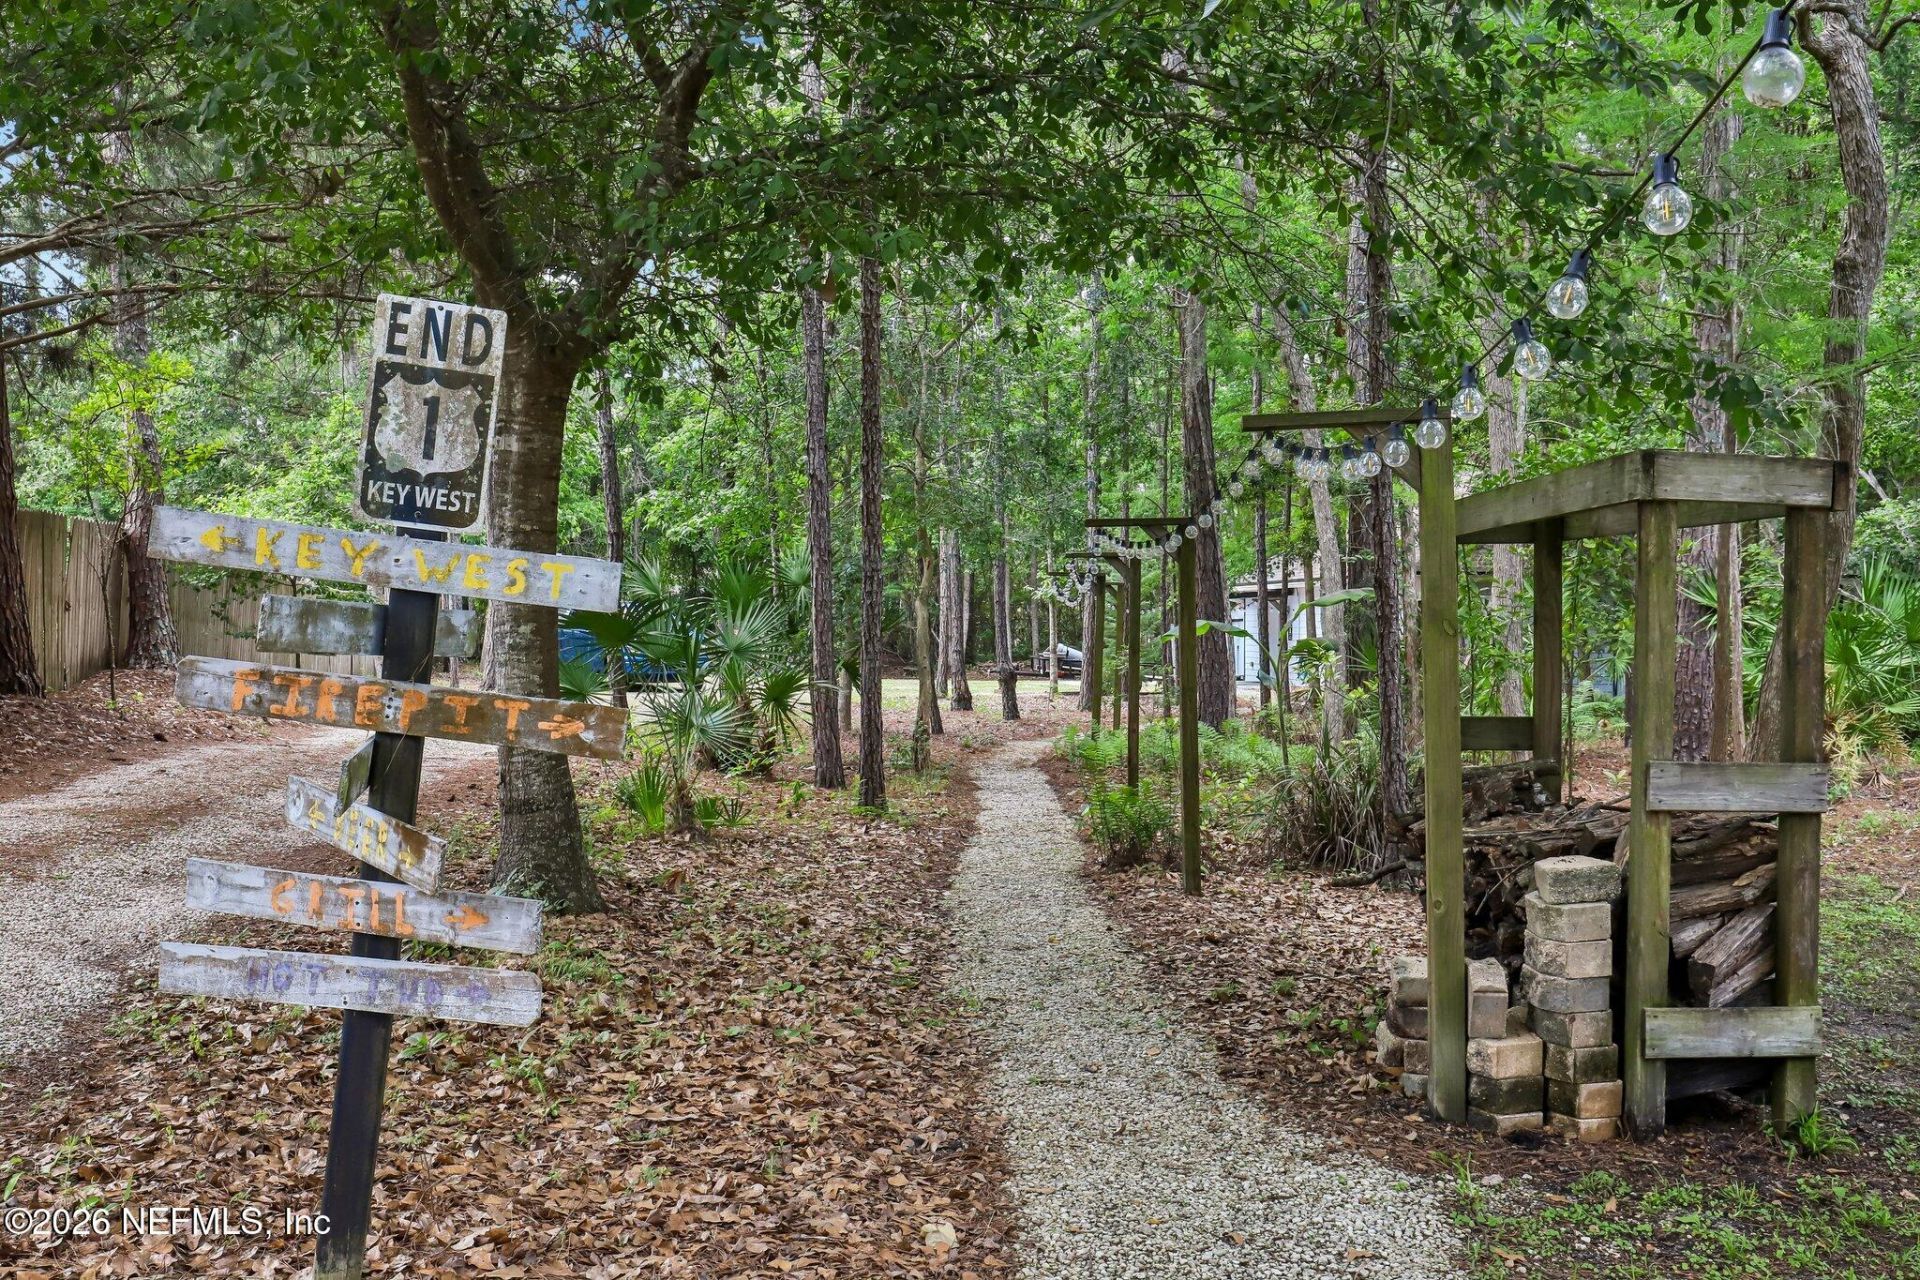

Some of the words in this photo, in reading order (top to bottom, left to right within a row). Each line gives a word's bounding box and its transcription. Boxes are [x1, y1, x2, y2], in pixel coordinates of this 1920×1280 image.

[386, 302, 493, 366] END
[423, 395, 441, 461] 1
[367, 480, 412, 504] KEY
[415, 485, 476, 514] WEST
[254, 527, 380, 576] KEY
[412, 548, 575, 600] WEST
[245, 957, 328, 997] HOT
